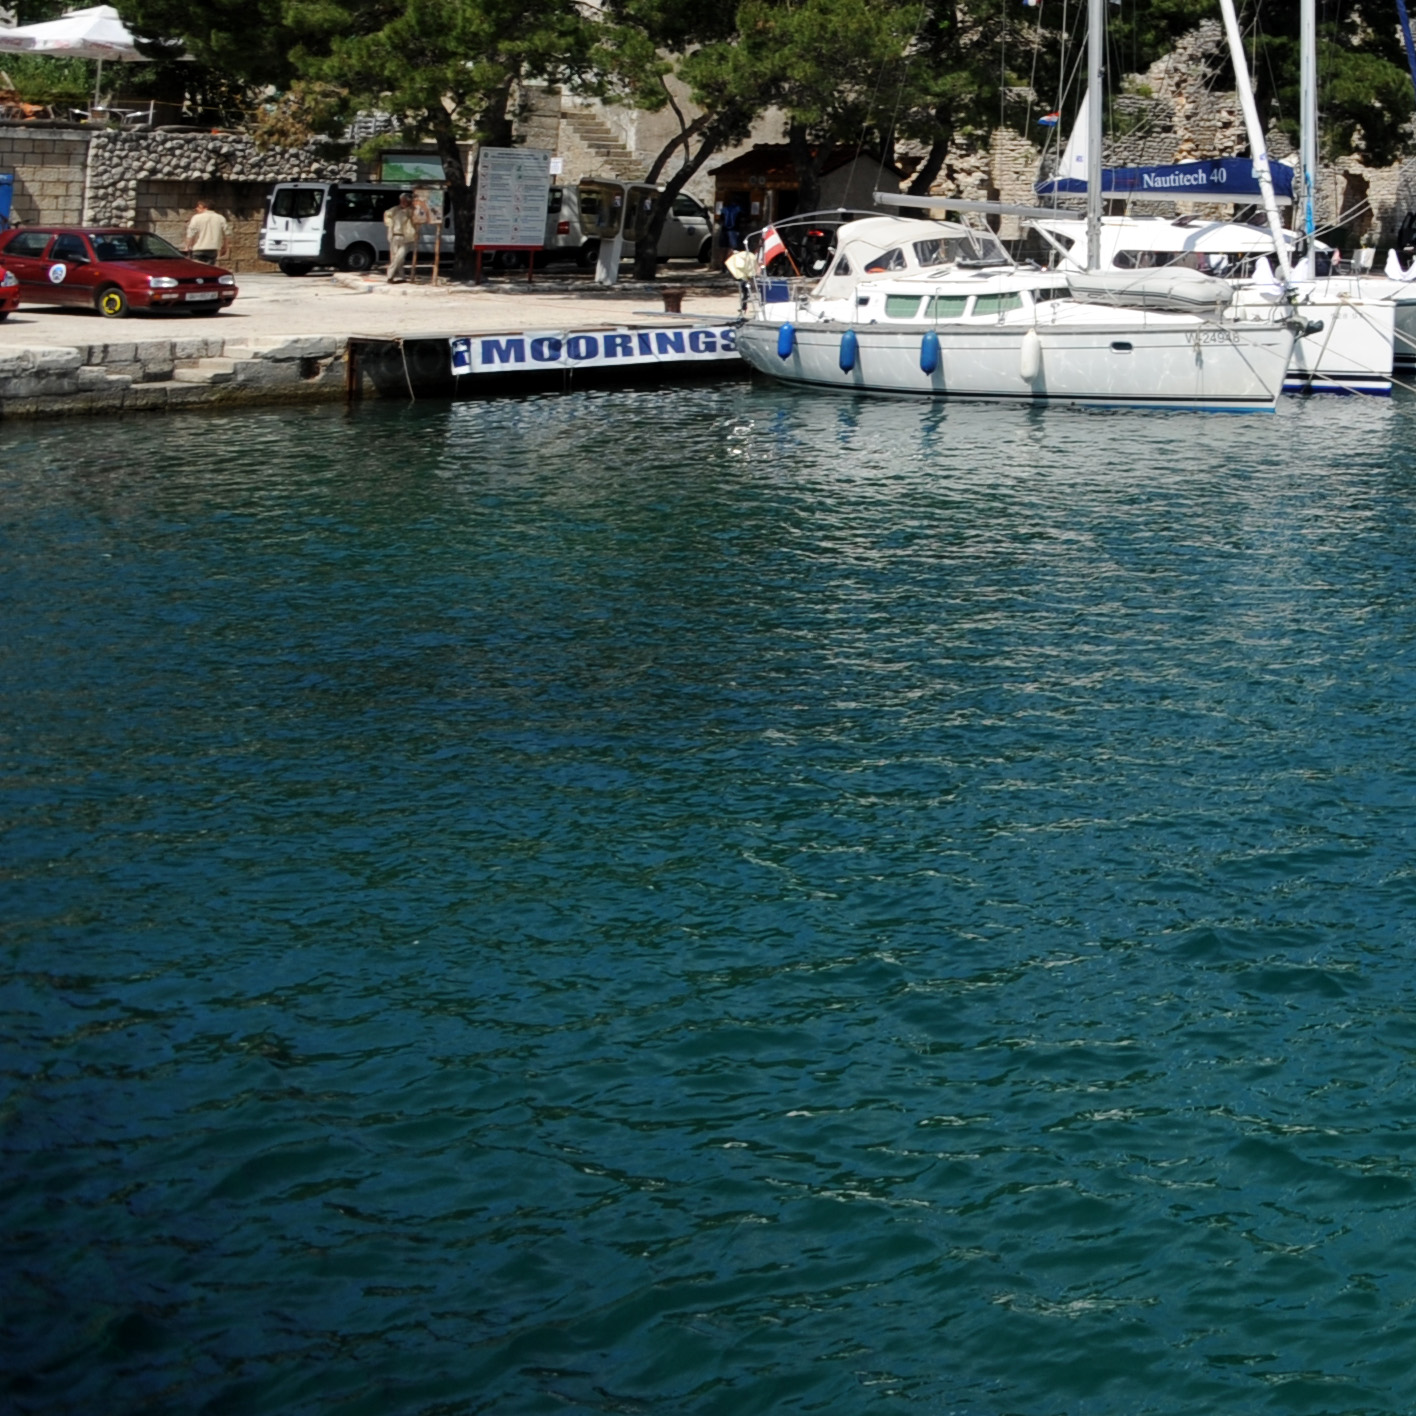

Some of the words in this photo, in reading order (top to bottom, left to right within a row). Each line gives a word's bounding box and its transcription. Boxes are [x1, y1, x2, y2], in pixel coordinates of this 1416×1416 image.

[1143, 169, 1207, 189] Nautitech
[1209, 167, 1227, 183] 40
[480, 329, 736, 365] MOORINGS
